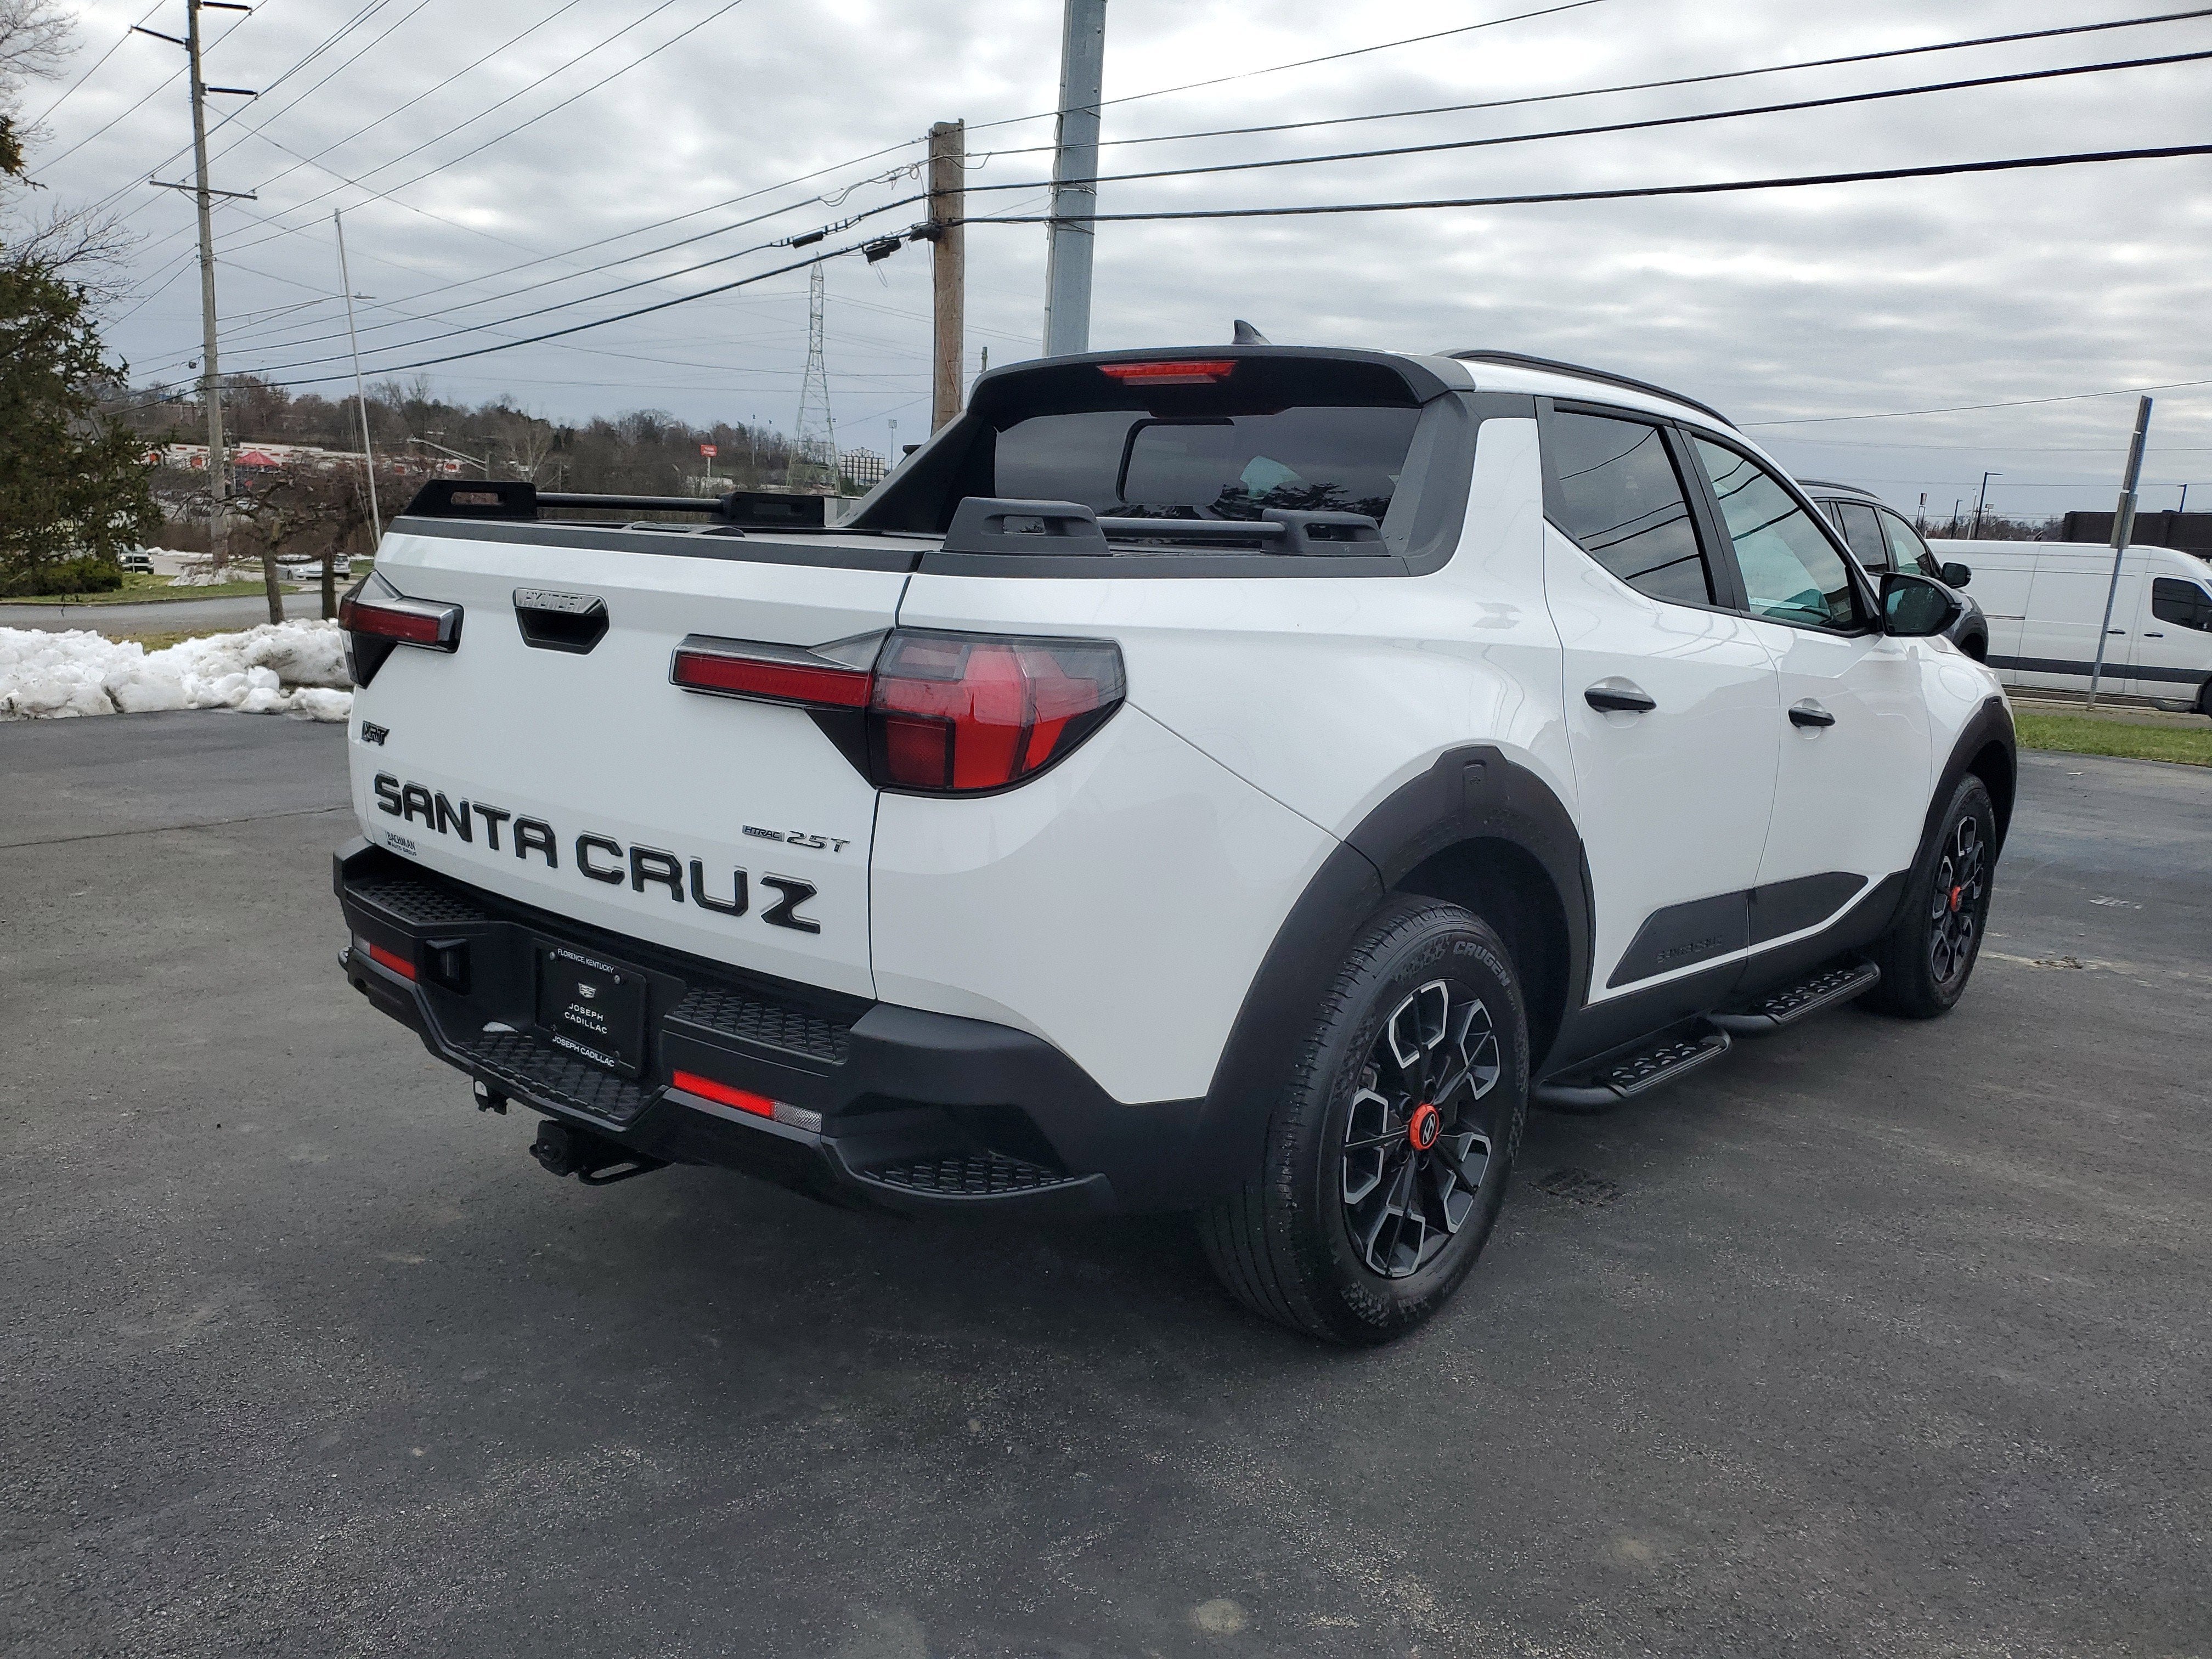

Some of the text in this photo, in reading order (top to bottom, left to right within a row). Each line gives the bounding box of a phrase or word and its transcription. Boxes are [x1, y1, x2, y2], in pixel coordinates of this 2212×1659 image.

[362, 720, 390, 746] XRT
[374, 771, 821, 934] SANTA CRUZ
[387, 831, 416, 850] BACHMAN
[557, 948, 614, 973] FLORENCE, KENTUCKY
[1454, 941, 1511, 986] CRUGEN
[565, 1012, 607, 1034] CADILLAC
[569, 1003, 603, 1022] JOSEPH
[552, 1036, 615, 1067] JOSEPH CADILLAC
